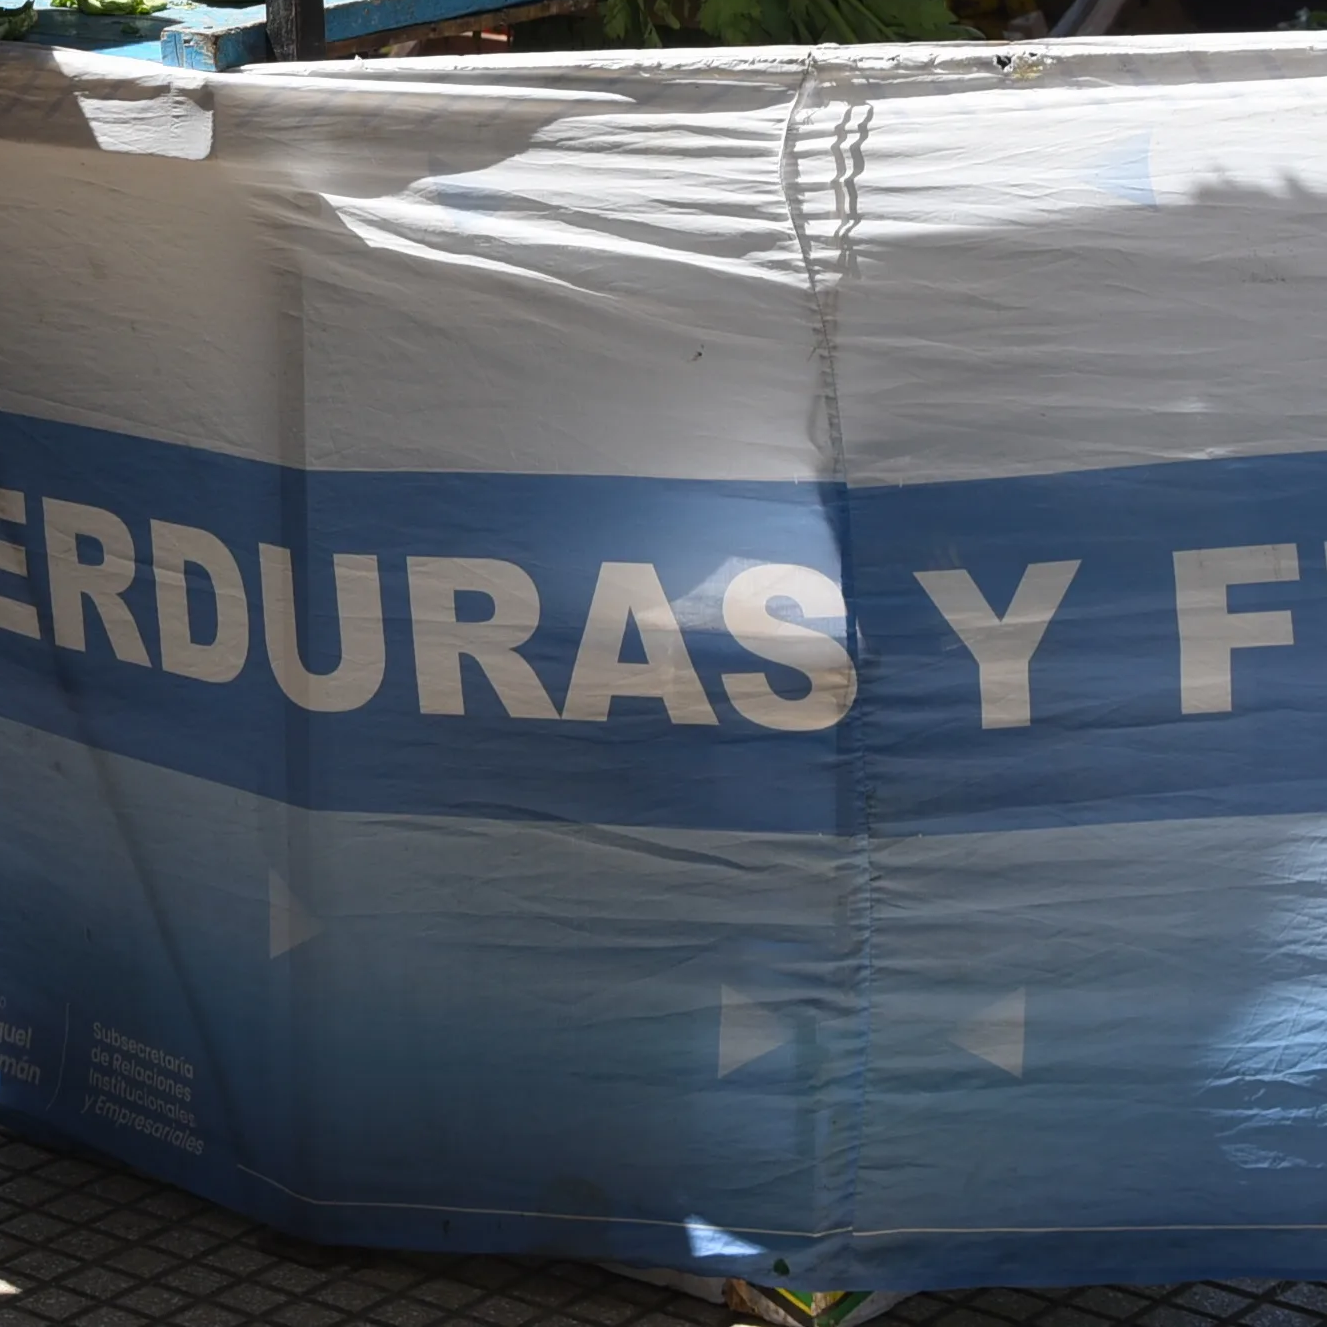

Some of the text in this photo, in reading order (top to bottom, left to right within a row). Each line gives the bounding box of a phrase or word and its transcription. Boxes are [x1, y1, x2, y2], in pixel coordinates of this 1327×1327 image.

[914, 558, 1082, 730] Y
[90, 1044, 193, 1103] de Relaciones
[92, 1021, 195, 1081] Subsecretaría
[81, 1093, 206, 1157] y Empresariales
[88, 1066, 198, 1129] Institucionales
